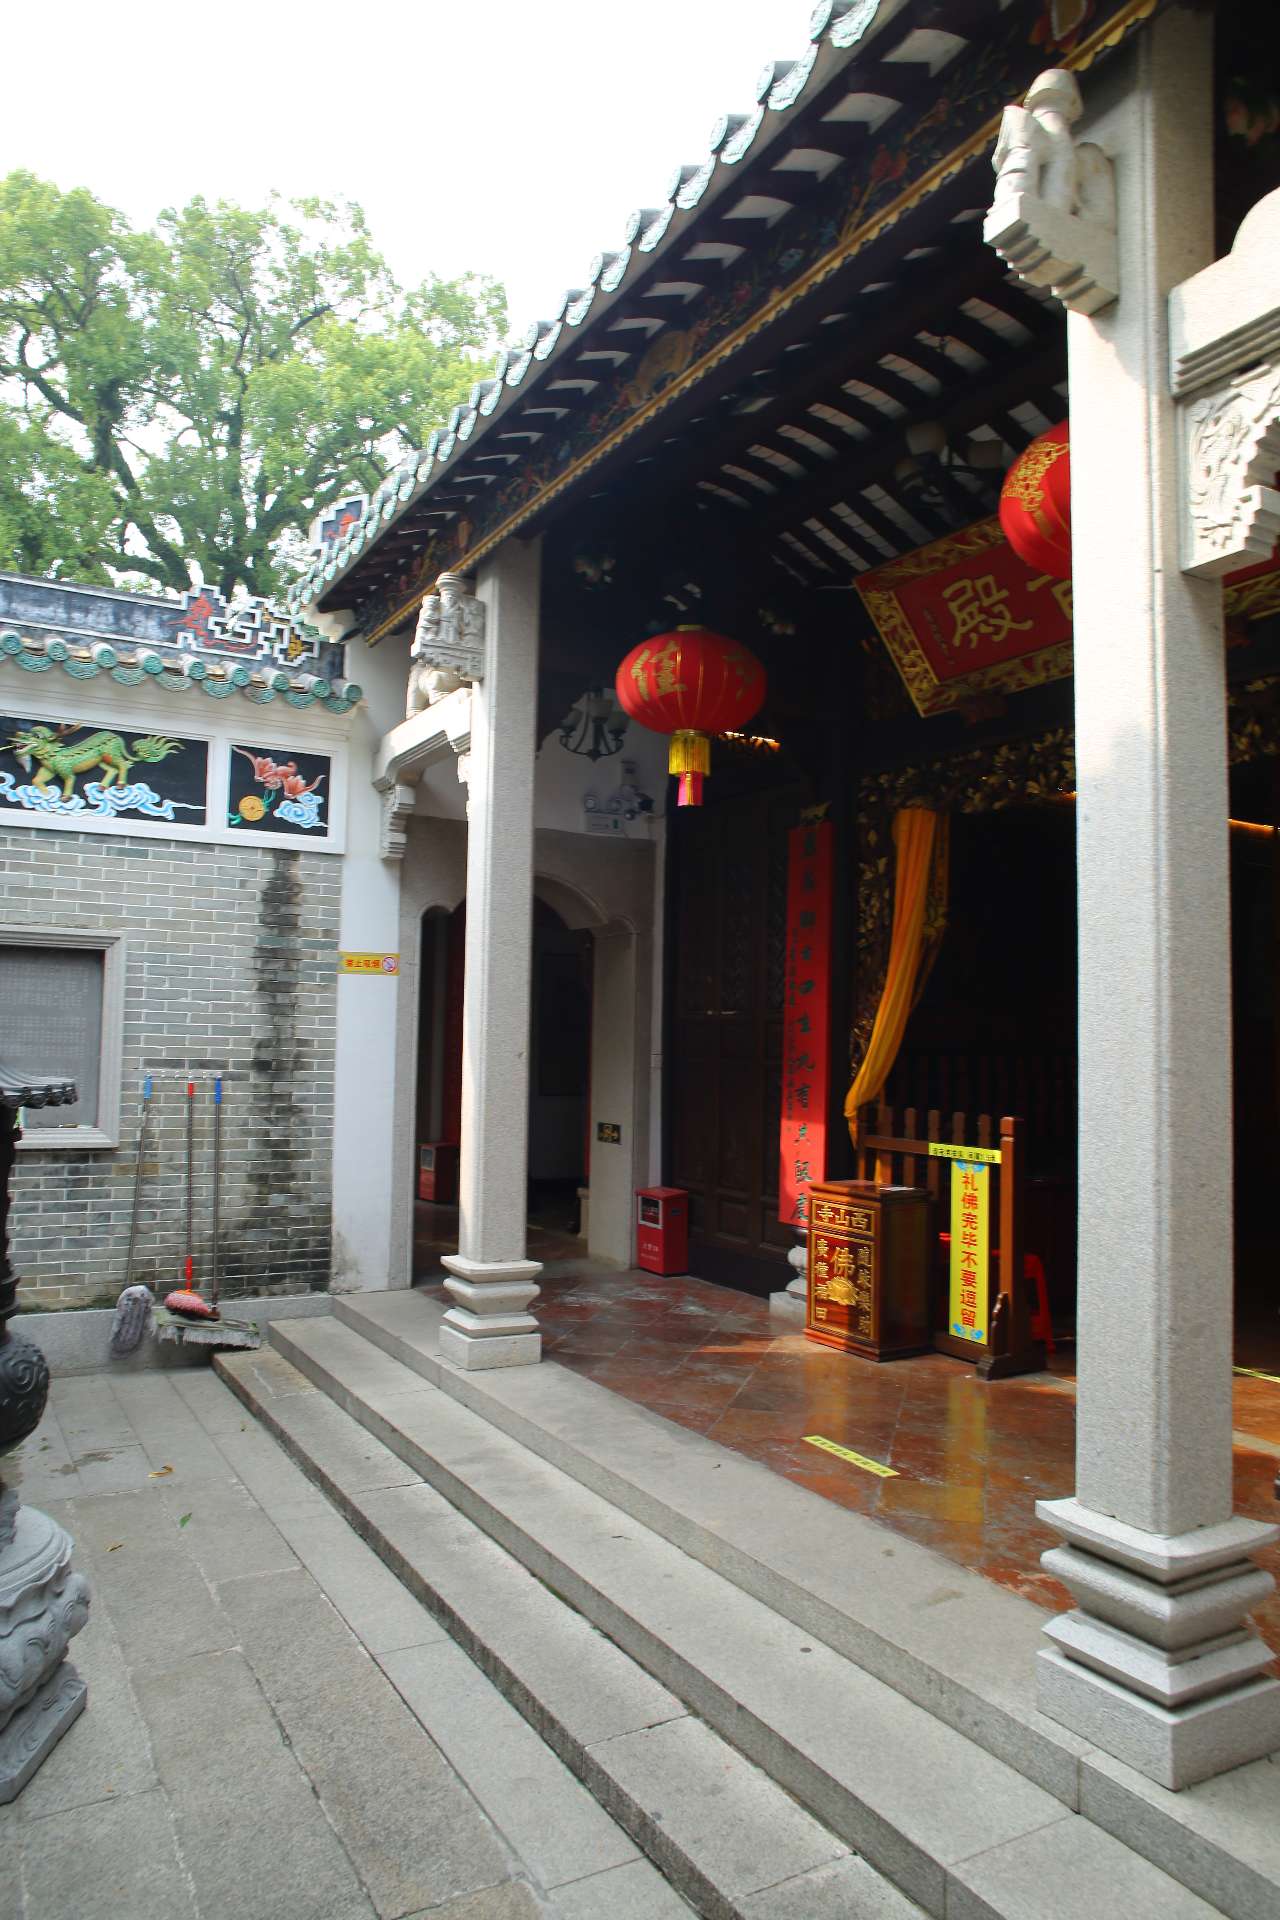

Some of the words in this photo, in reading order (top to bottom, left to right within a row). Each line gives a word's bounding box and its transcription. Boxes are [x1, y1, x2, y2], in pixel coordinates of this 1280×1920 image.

[830, 1246, 855, 1277] 佛
[960, 1172, 979, 1328] 礼佛完毕不要逗留
